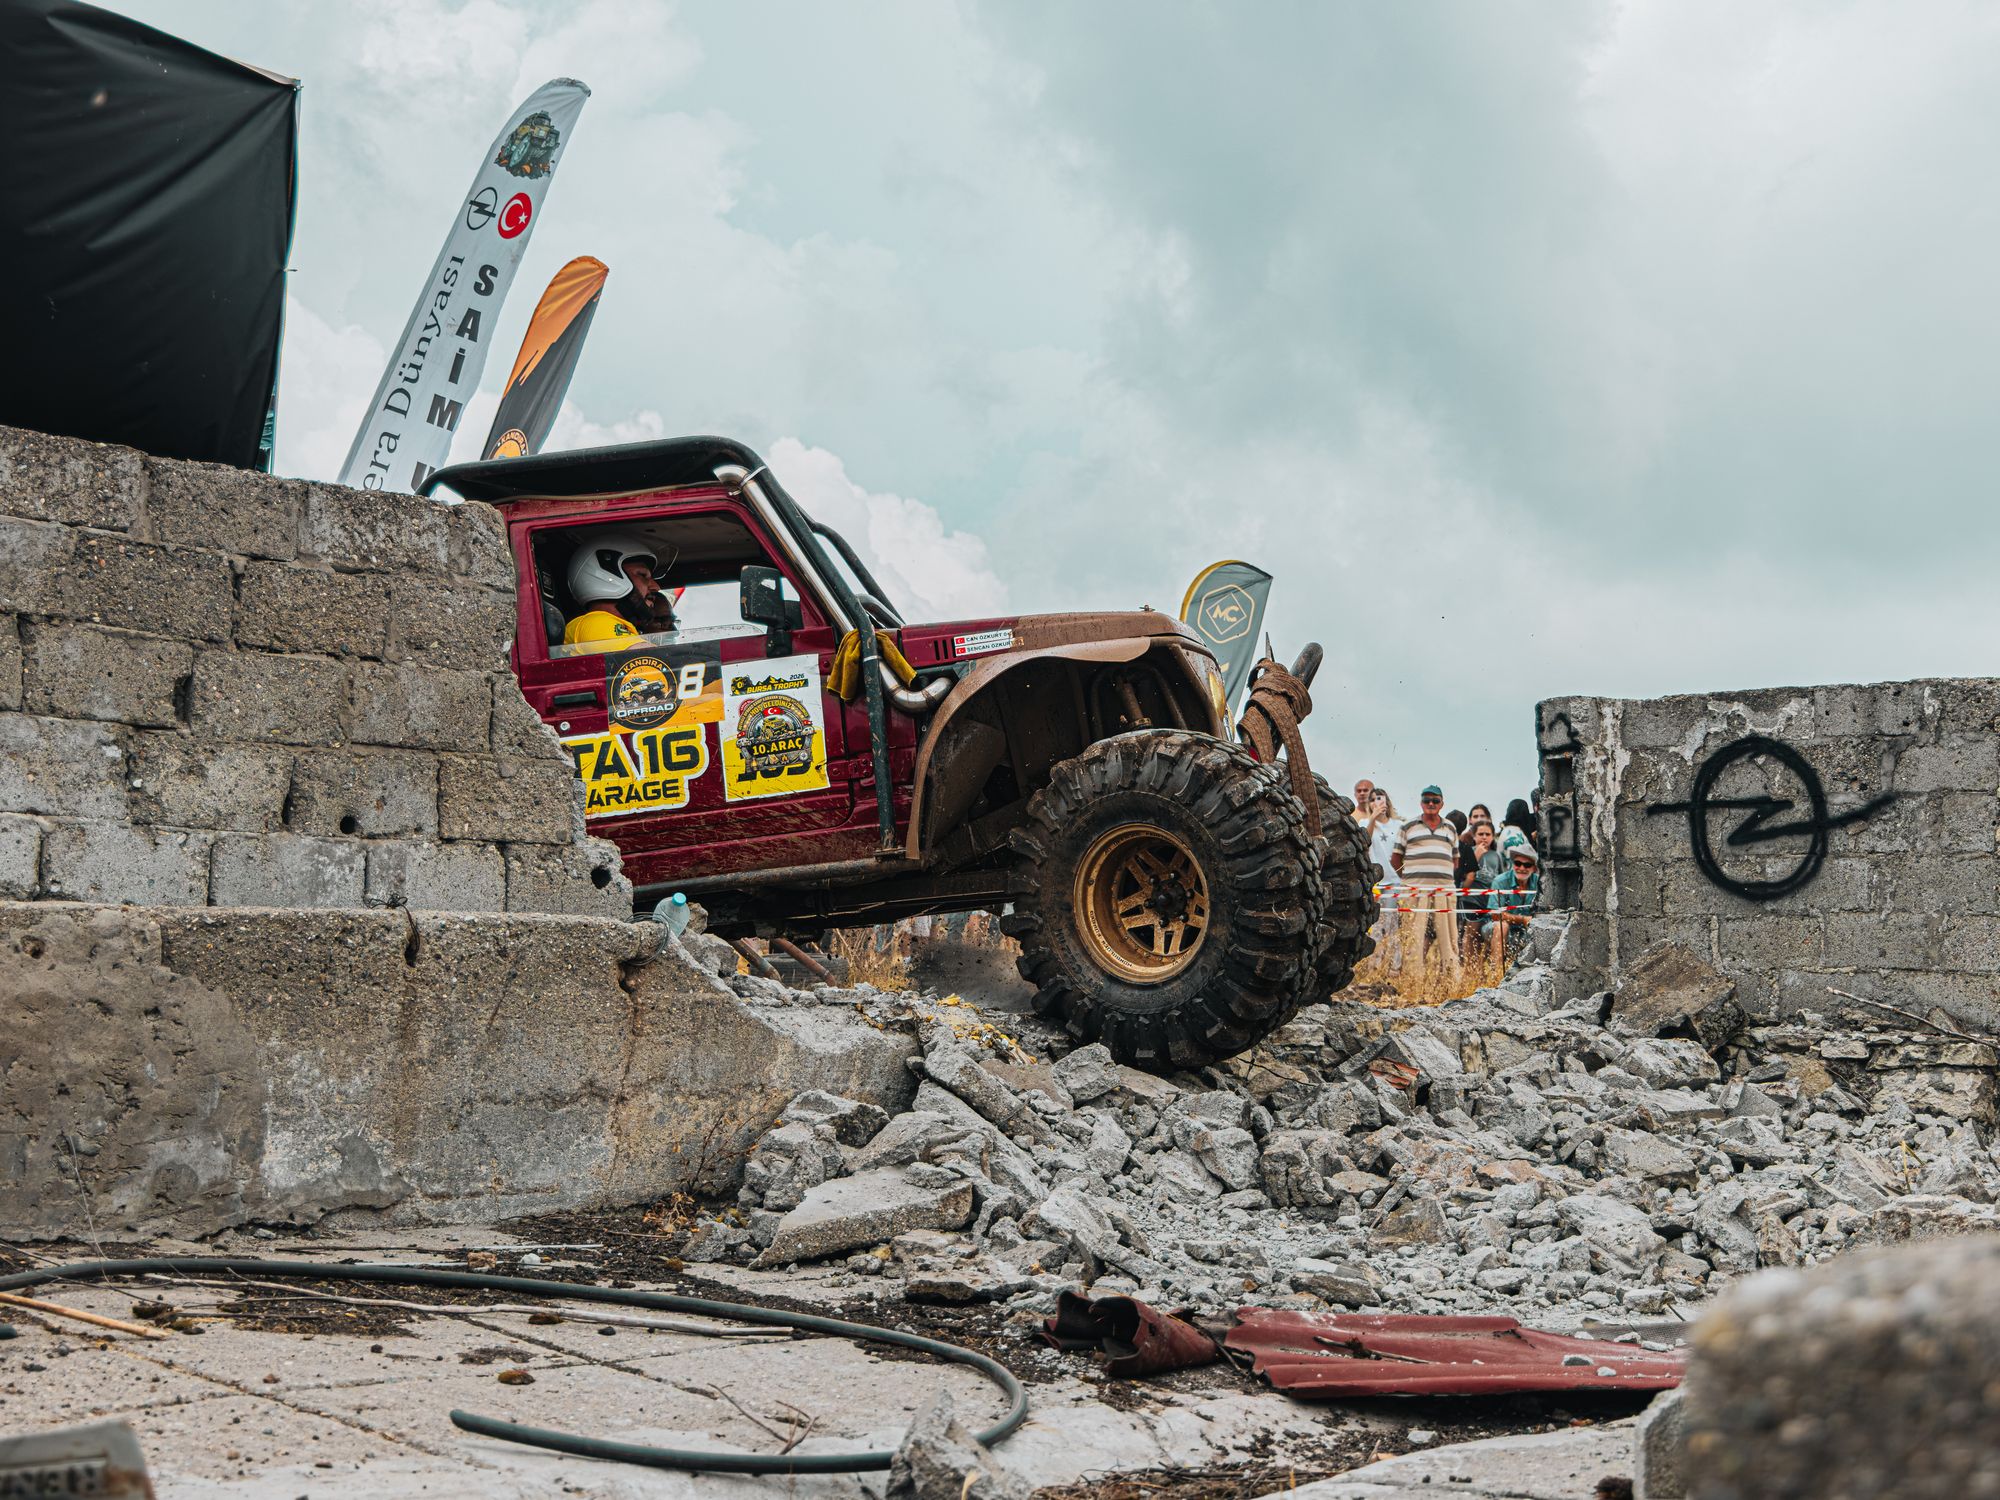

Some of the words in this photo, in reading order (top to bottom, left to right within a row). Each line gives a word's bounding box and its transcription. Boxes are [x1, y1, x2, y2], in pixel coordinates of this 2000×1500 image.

[383, 255, 465, 419] Dünyası
[1212, 604, 1240, 622] MC
[623, 658, 663, 673] KANDIRA
[678, 663, 706, 700] 8
[746, 685, 772, 694] BURSA
[773, 680, 805, 690] TROPHY
[616, 703, 675, 718] OFFROAD
[752, 737, 803, 756] 10.ARAÇ
